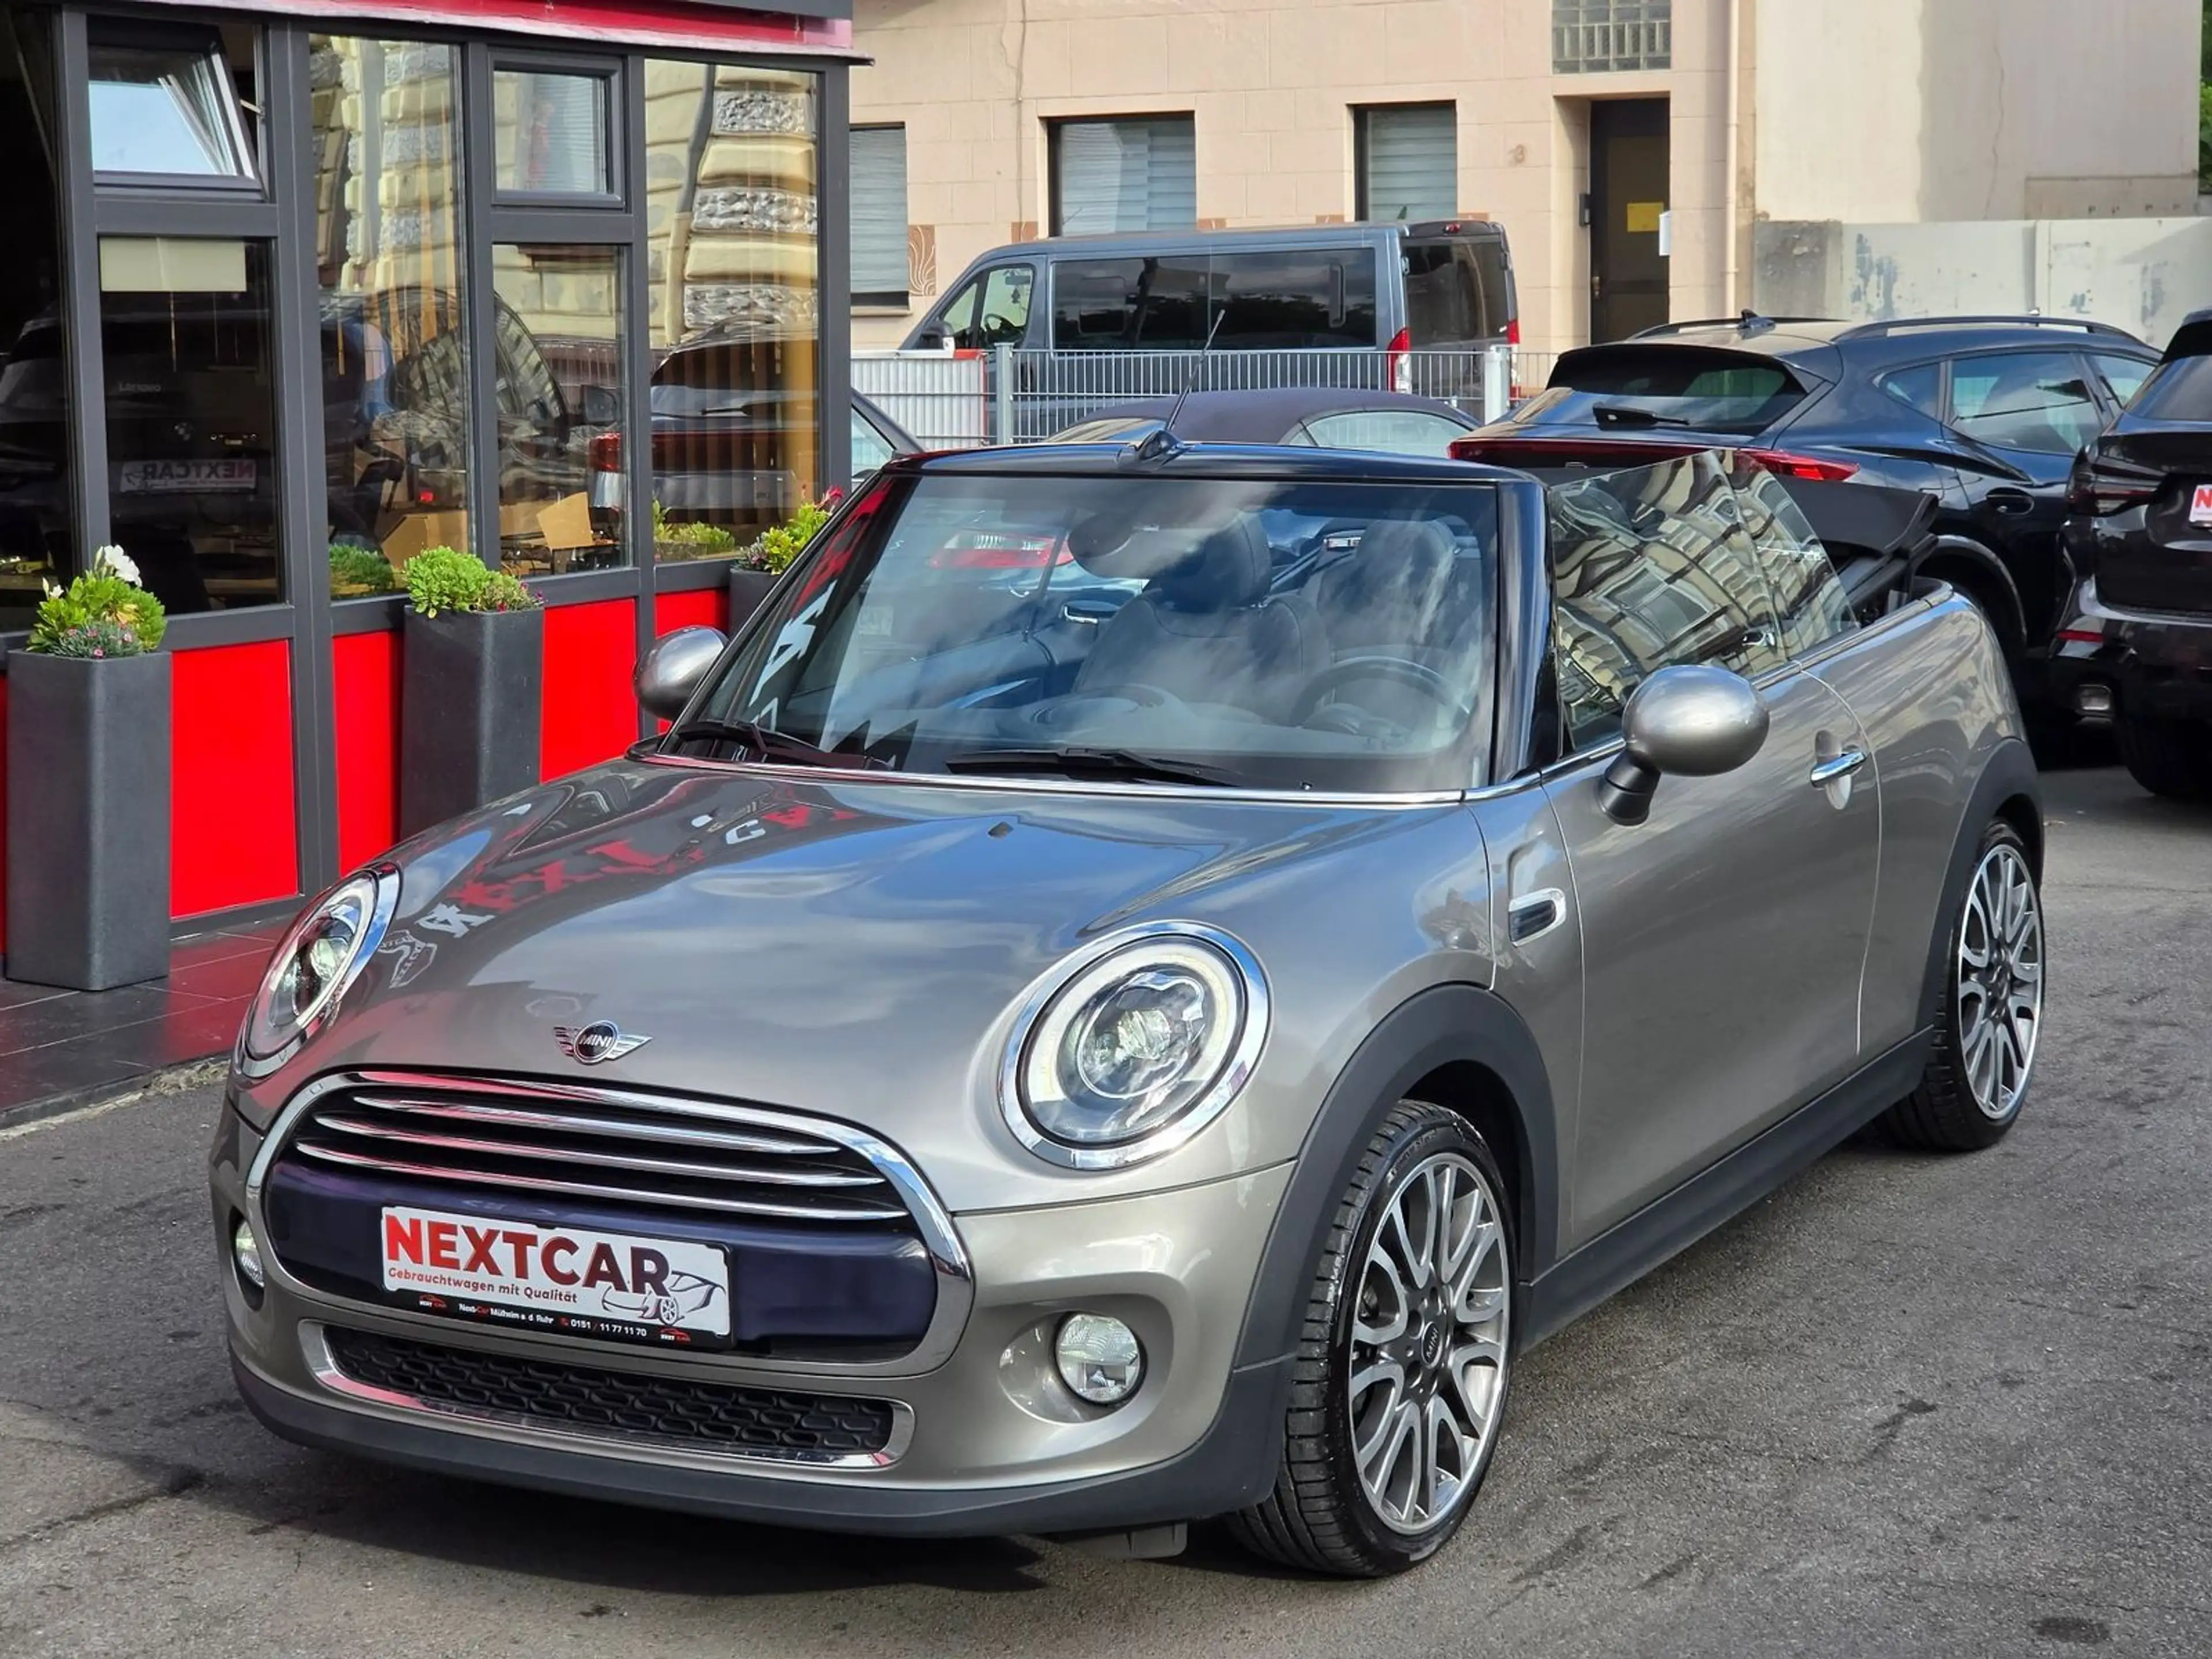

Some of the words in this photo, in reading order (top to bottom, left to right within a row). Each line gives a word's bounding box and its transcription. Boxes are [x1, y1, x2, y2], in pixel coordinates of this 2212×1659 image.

[579, 1035, 612, 1047] MINI
[385, 1214, 671, 1297] NEXTCAR
[388, 1267, 494, 1292] Gebrauchtwagen
[498, 1283, 520, 1296] mit
[524, 1286, 577, 1304] Qualität
[571, 1319, 591, 1330] 0151
[1426, 1328, 1439, 1358] MINI
